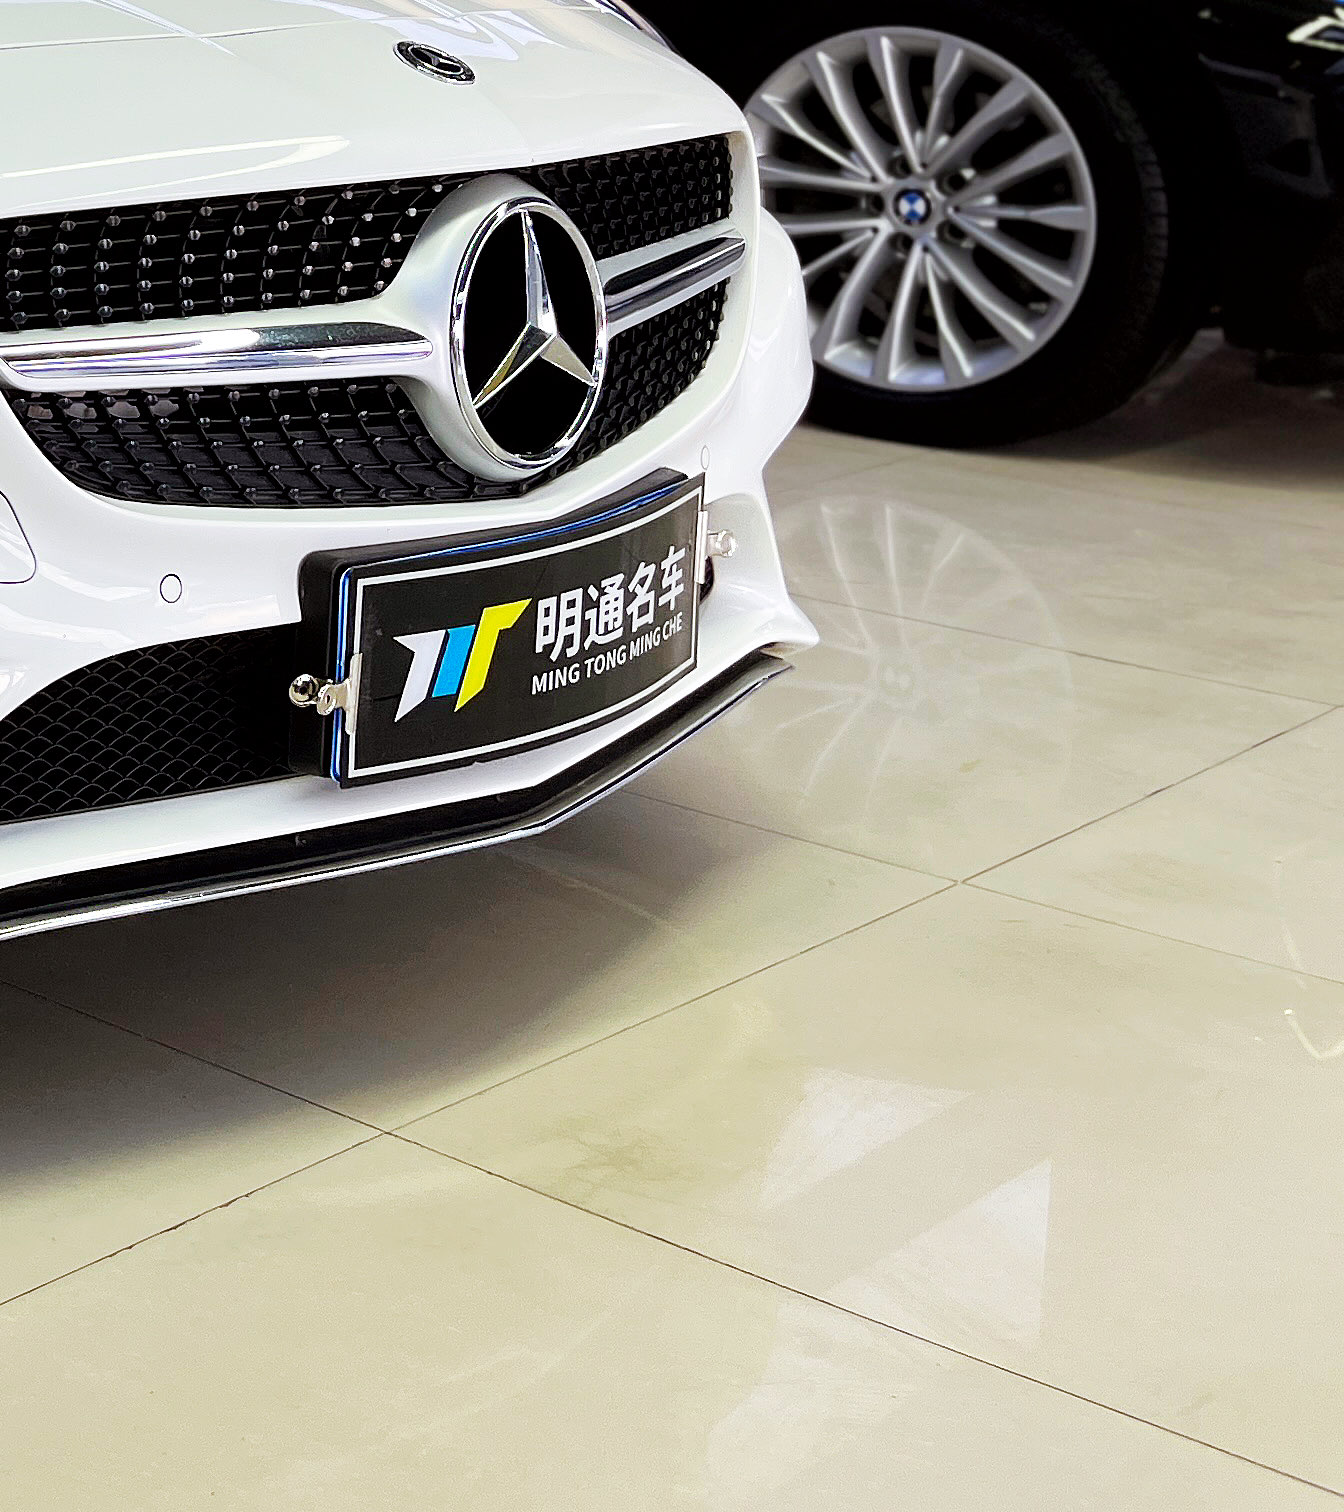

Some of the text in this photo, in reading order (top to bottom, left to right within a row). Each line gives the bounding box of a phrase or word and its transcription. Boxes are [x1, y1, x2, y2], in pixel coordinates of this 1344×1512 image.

[535, 544, 686, 662] 明通名车
[531, 612, 683, 695] MING TONG MING CHE
